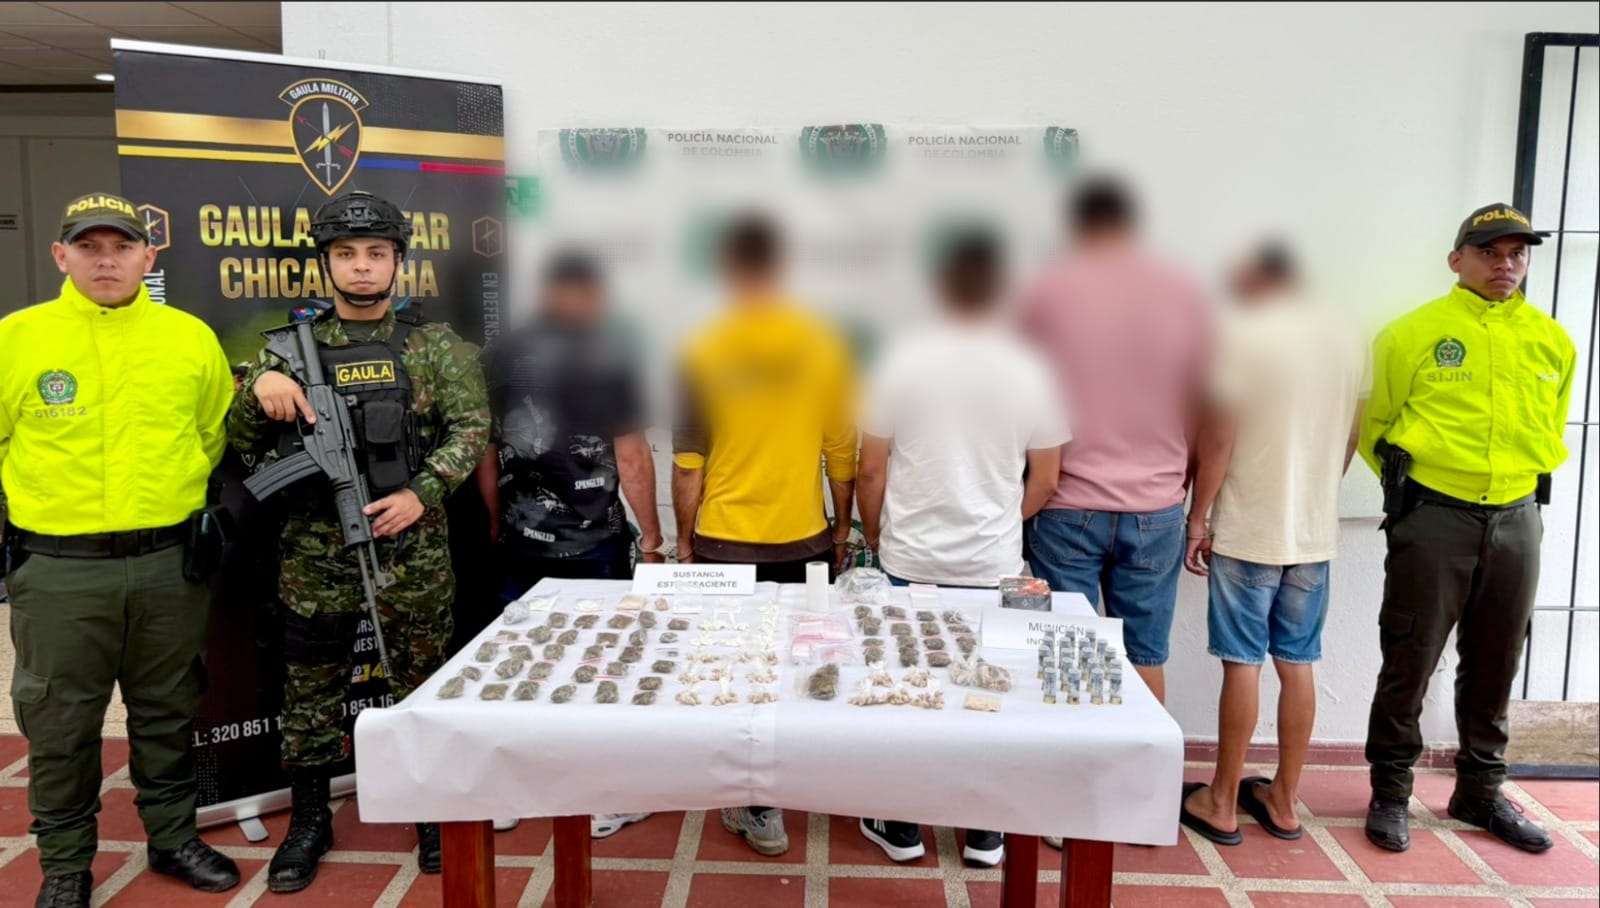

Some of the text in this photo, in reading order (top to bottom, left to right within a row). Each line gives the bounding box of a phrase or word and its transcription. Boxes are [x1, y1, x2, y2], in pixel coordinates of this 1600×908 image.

[289, 83, 360, 105] GAULA MILITAR
[667, 131, 779, 144] POLICÍA NACIONAL
[908, 133, 1022, 145] POLICÍA NACIONAL
[66, 196, 136, 217] POLICIA
[199, 204, 315, 248] GAULA
[219, 256, 440, 299] CHICAHA
[481, 272, 499, 288] EN
[339, 364, 392, 382] GAULA
[1427, 371, 1473, 383] SIJIN
[211, 722, 240, 743] 320
[243, 718, 270, 737] 851
[350, 697, 374, 716] 851
